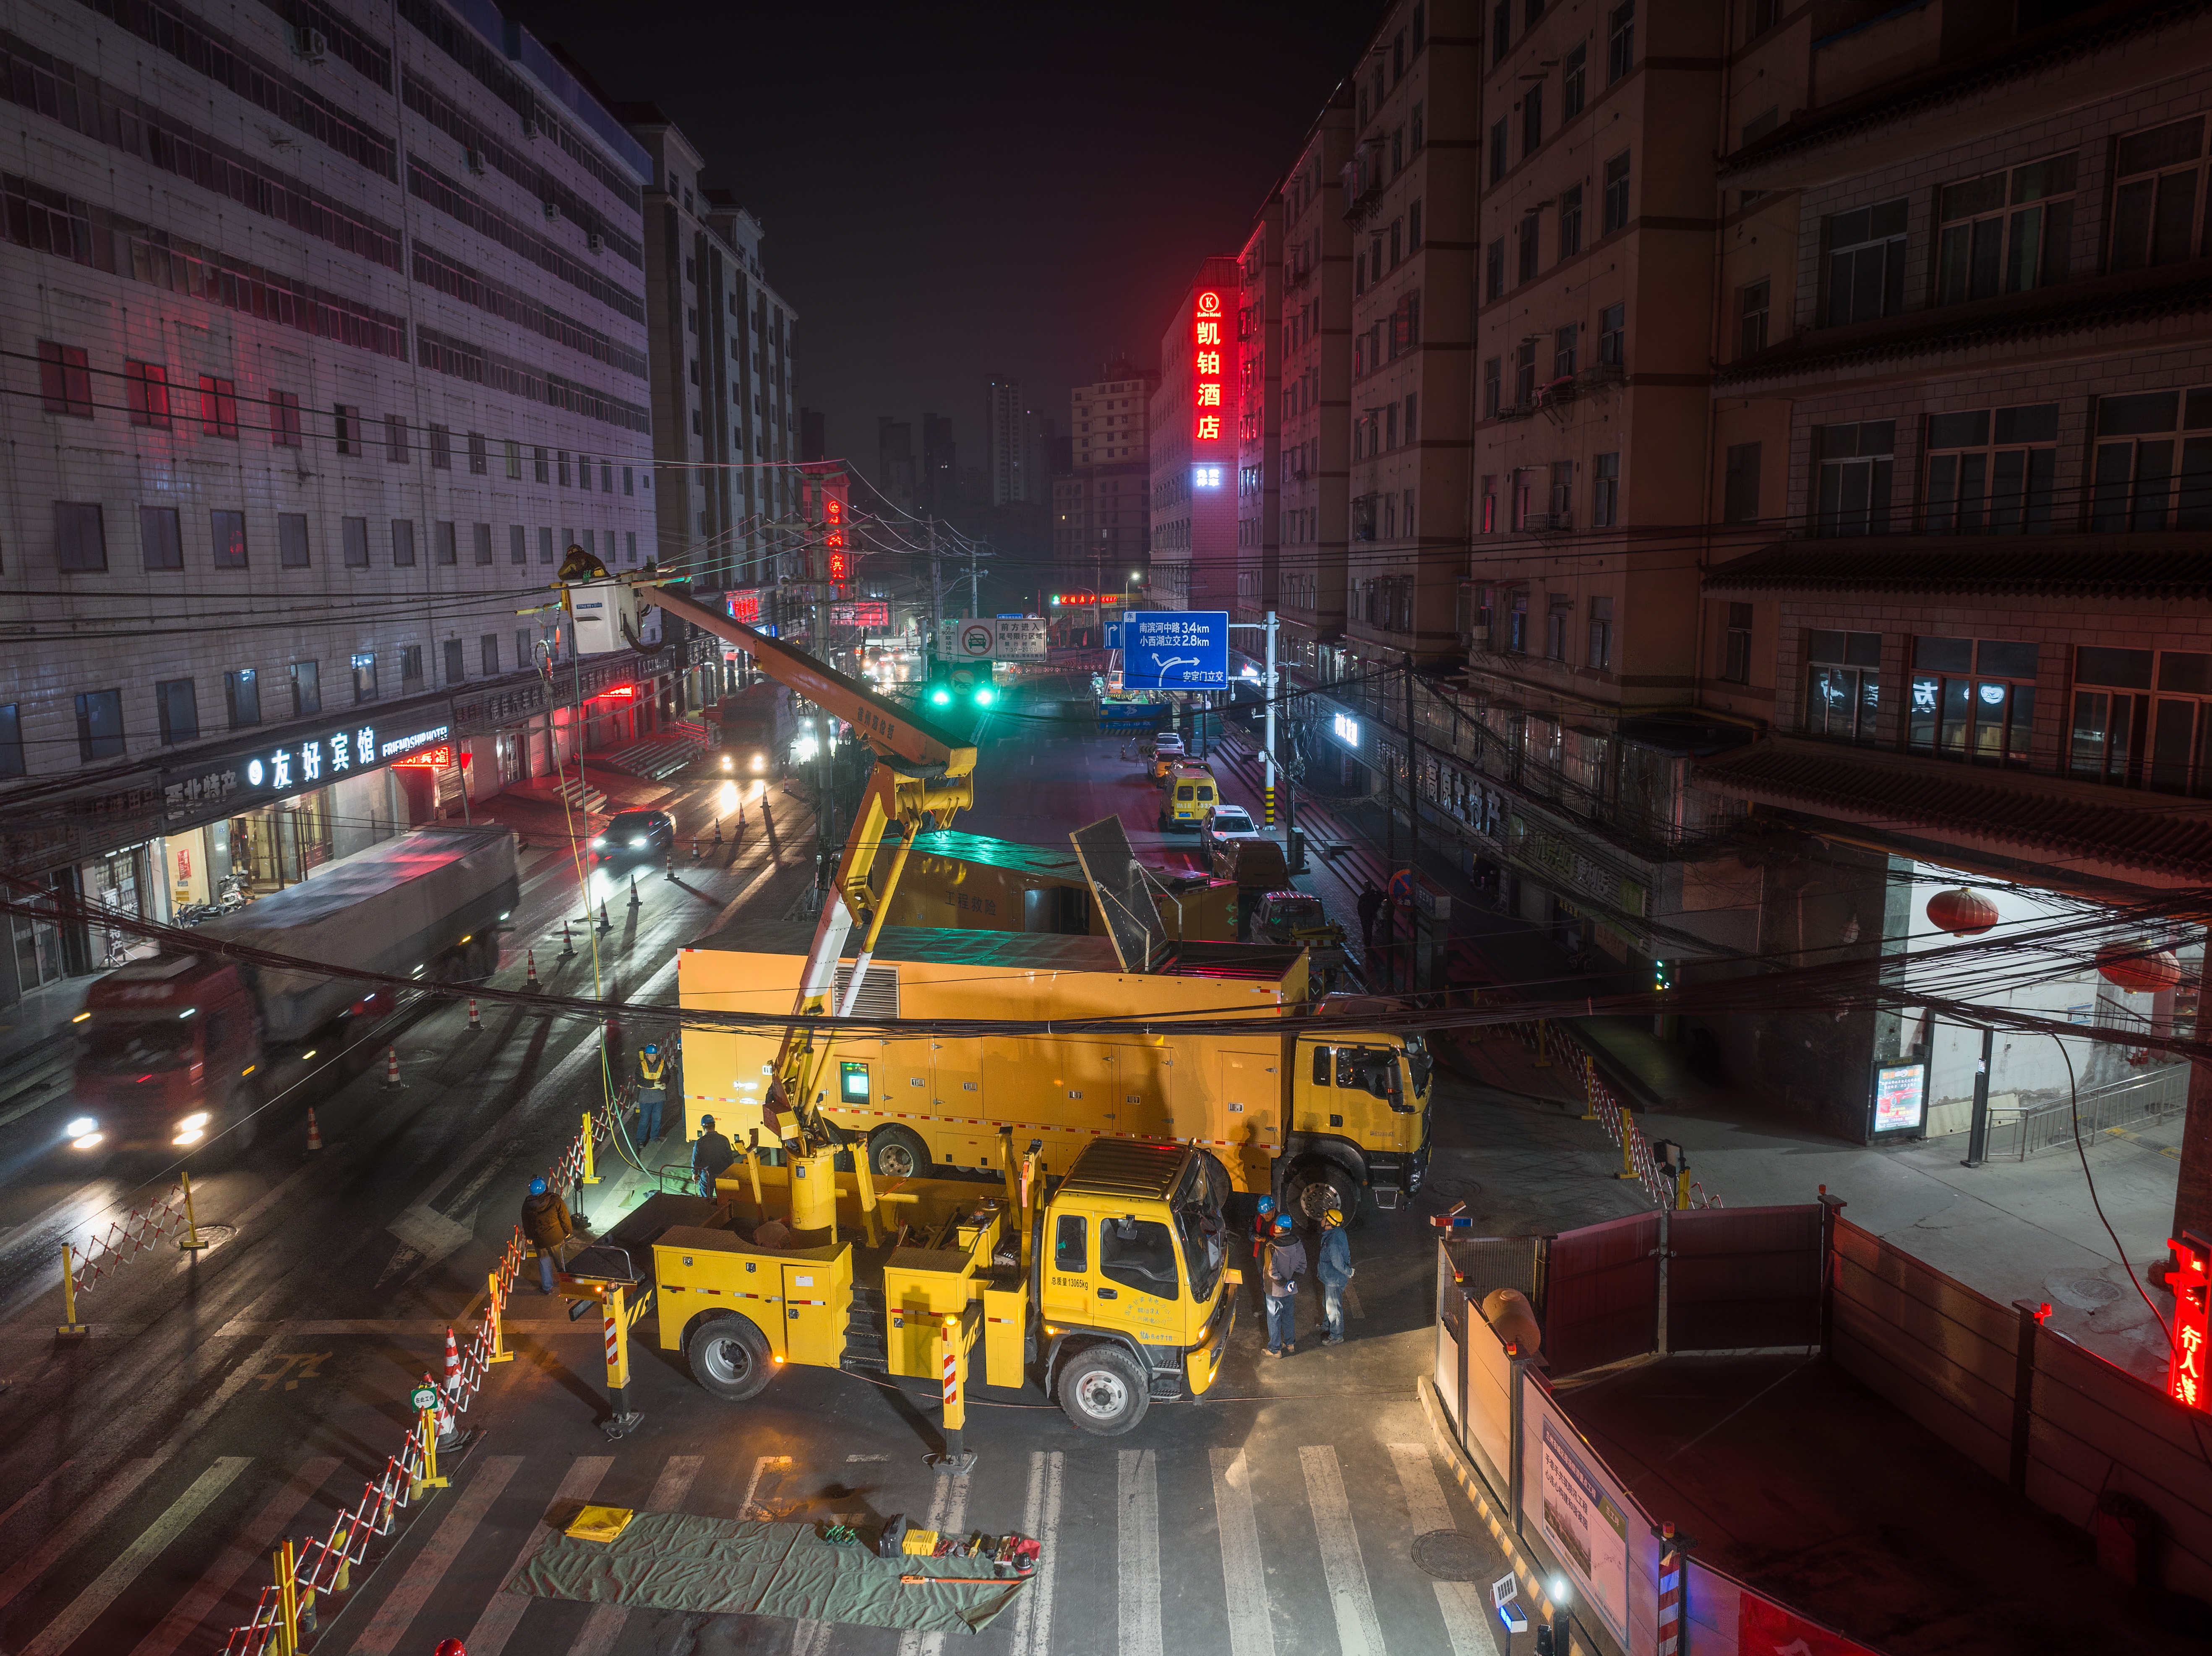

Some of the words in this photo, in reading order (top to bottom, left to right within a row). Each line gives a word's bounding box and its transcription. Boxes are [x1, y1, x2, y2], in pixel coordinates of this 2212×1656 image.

[1197, 321, 1221, 439] 凯铂酒店
[1139, 622, 1179, 634] 南滨河中路
[1182, 622, 1209, 634] 3.4km
[1140, 635, 1181, 647] 小西湖立交
[1182, 635, 1209, 647] 2.8km
[1183, 671, 1224, 682] 安定门立交
[272, 726, 375, 790] 友好宾馆
[945, 890, 996, 915] 工程救险
[415, 1395, 434, 1403] 在此工作
[1545, 1453, 1588, 1515] 手牵手共筑防汛工程
[1545, 1469, 1588, 1531] 心连心构建和谐家园
